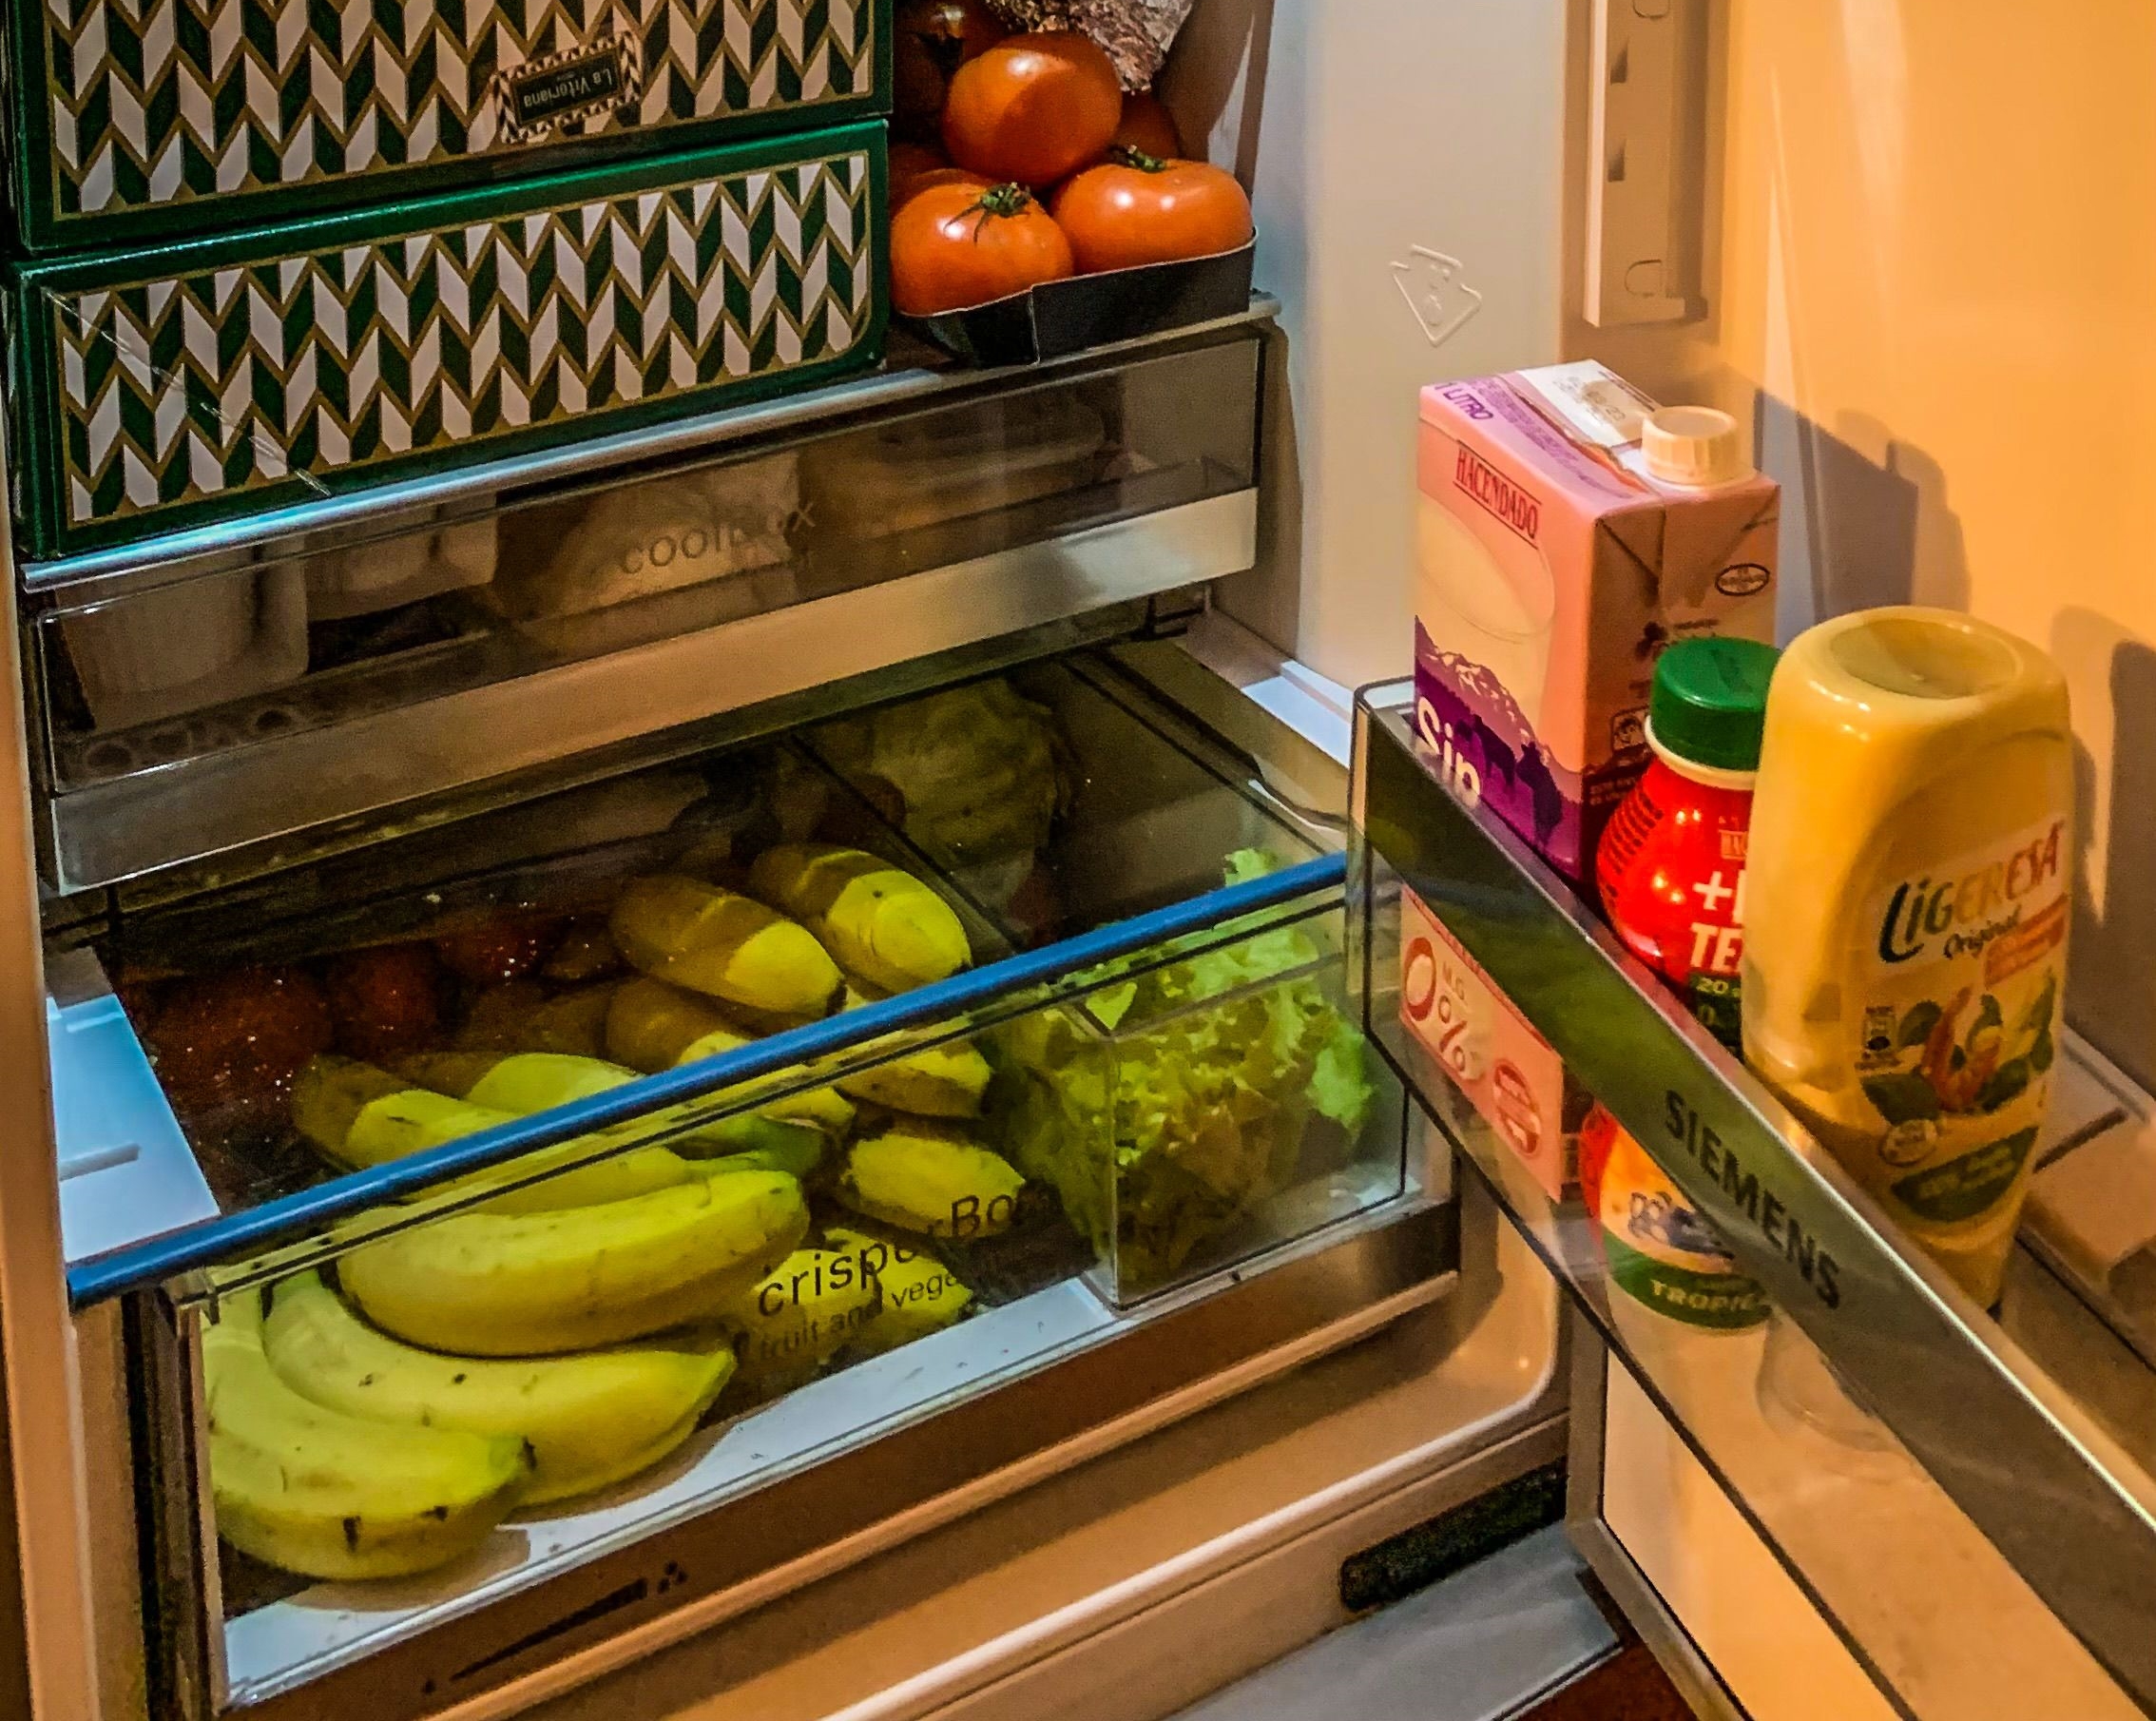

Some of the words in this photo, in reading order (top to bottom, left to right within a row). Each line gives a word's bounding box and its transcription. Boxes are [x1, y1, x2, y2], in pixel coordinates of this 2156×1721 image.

[592, 67, 613, 87] La
[1442, 386, 1494, 421] LITRO
[1455, 448, 1538, 540] HACENDADO
[1665, 1090, 1841, 1309] SIEMENS
